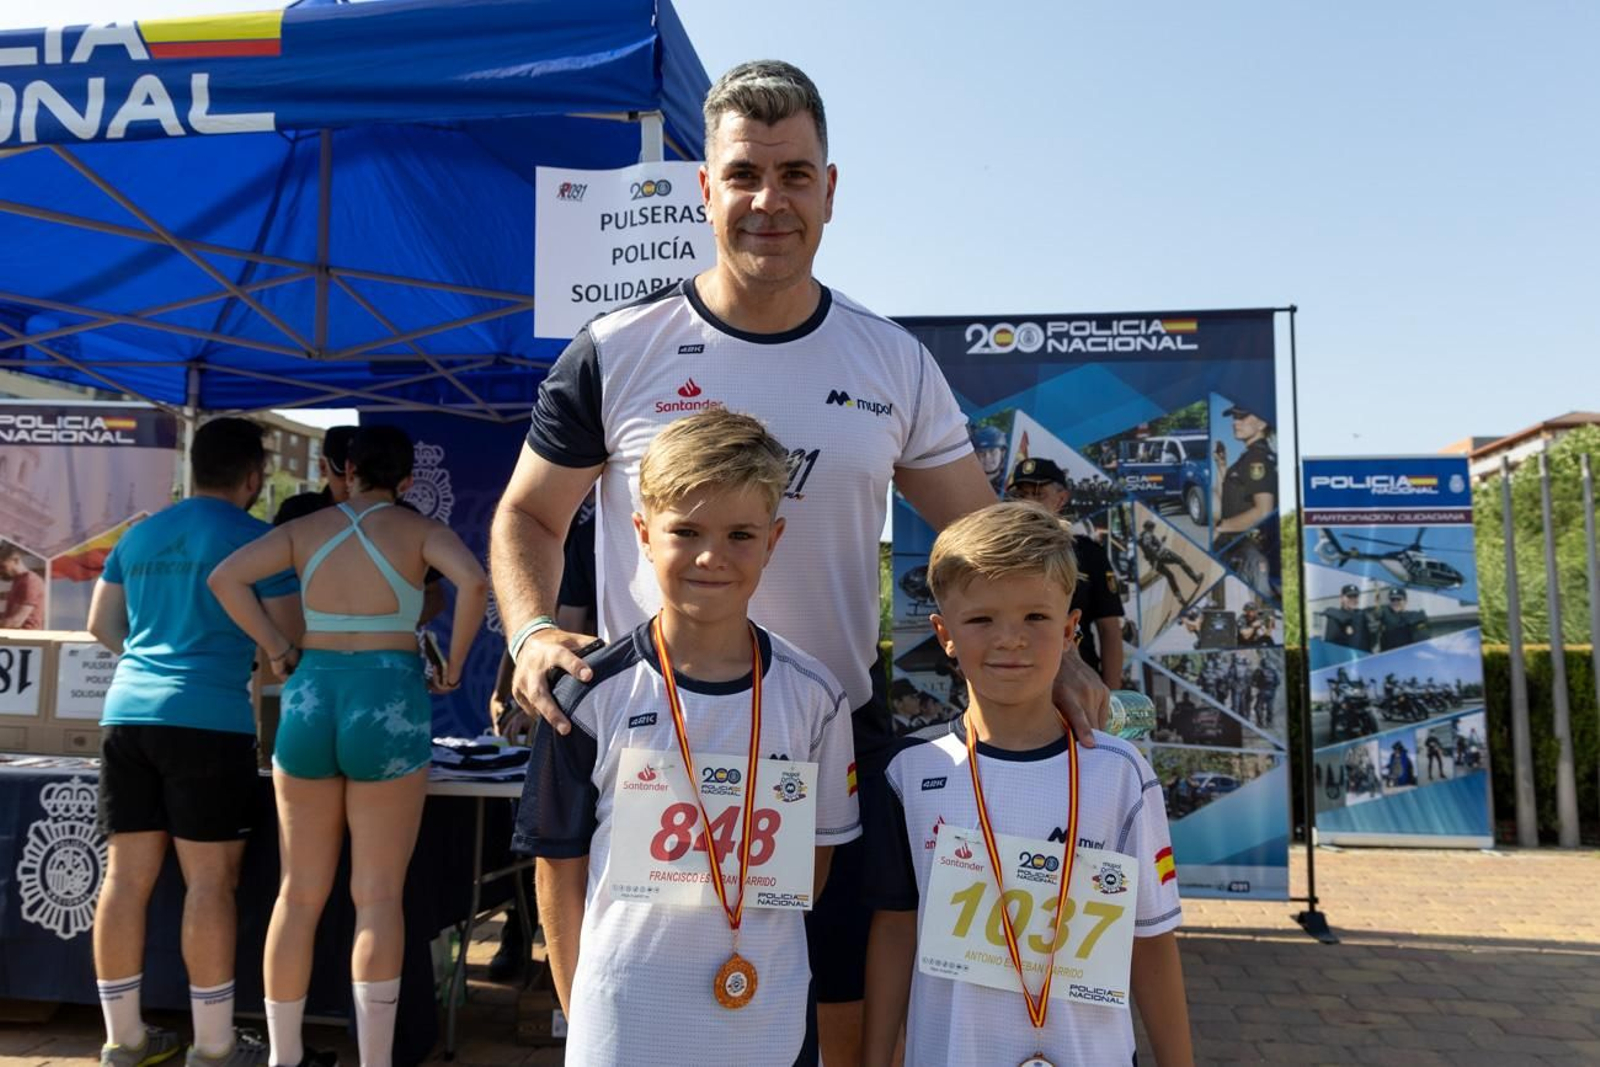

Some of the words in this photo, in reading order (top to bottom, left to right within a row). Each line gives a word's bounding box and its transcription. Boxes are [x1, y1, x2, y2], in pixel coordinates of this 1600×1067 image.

[600, 204, 708, 231] PULSERAS
[612, 236, 696, 265] POLICÍA
[1047, 319, 1166, 337] POLICIA
[1047, 335, 1198, 353] NACIONAL
[857, 399, 893, 416] mupol
[1311, 475, 1412, 489] POLICIA
[623, 781, 669, 792] Santander
[650, 802, 782, 867] 848
[940, 856, 984, 873] Santander
[649, 871, 698, 884] FRANCISCO
[742, 875, 776, 887] ARRIDO
[757, 892, 798, 900] POLICIA
[757, 898, 809, 908] NACIONAL
[950, 881, 1125, 960] 1037
[1069, 984, 1113, 997] POLICIA
[1069, 991, 1124, 1005] NACIONAL
